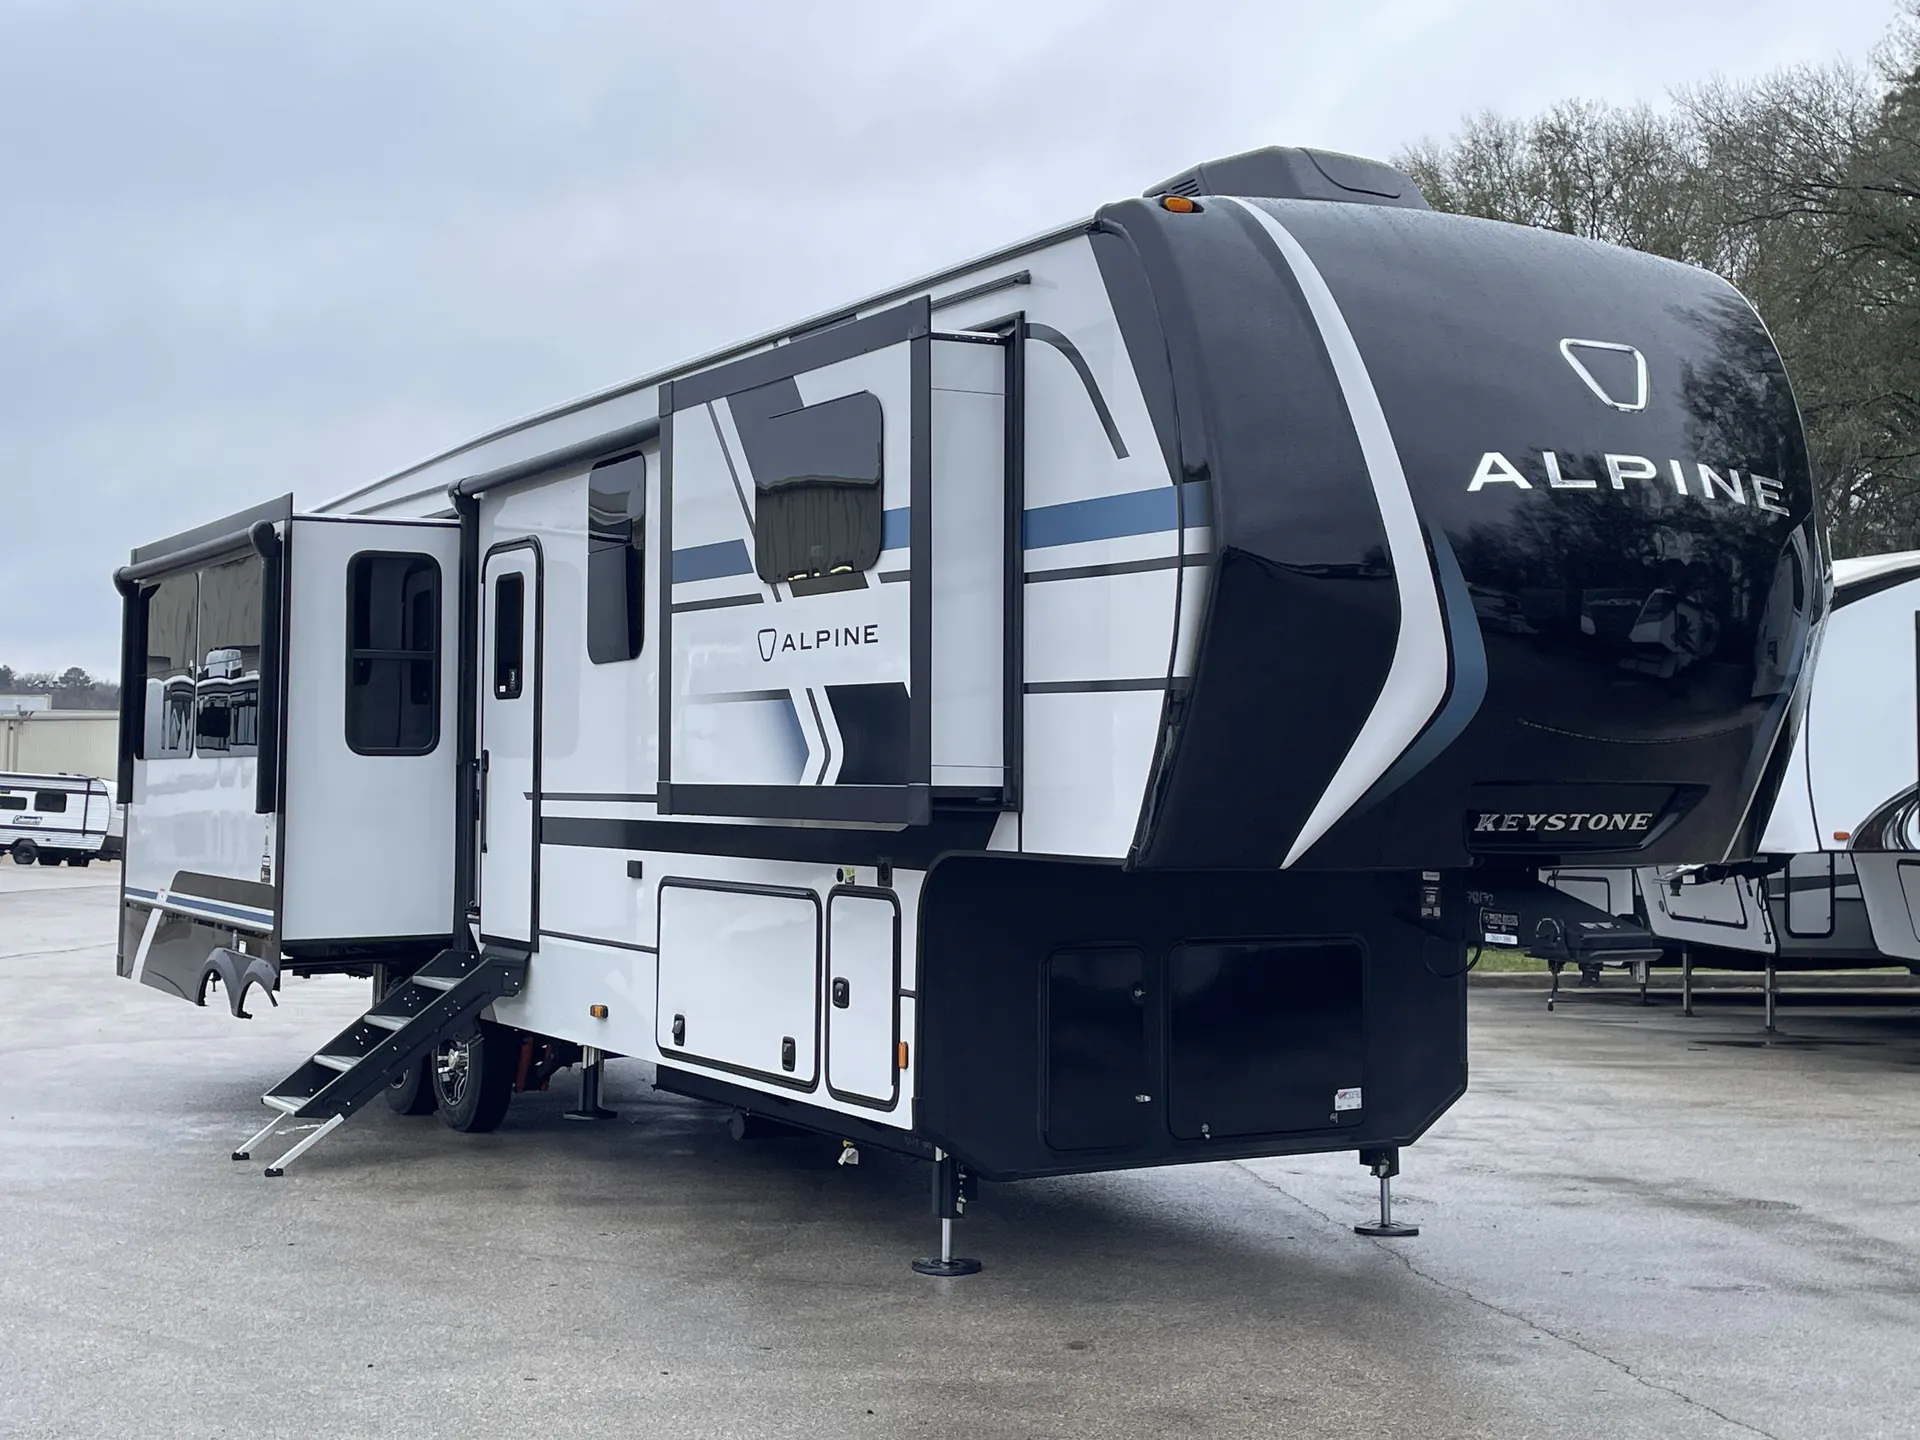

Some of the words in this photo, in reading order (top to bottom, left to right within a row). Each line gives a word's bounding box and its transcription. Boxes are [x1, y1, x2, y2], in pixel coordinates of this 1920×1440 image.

[1466, 450, 1791, 518] ALPINE
[781, 624, 879, 652] ALPINE
[1474, 812, 1653, 832] KEYSTONE
